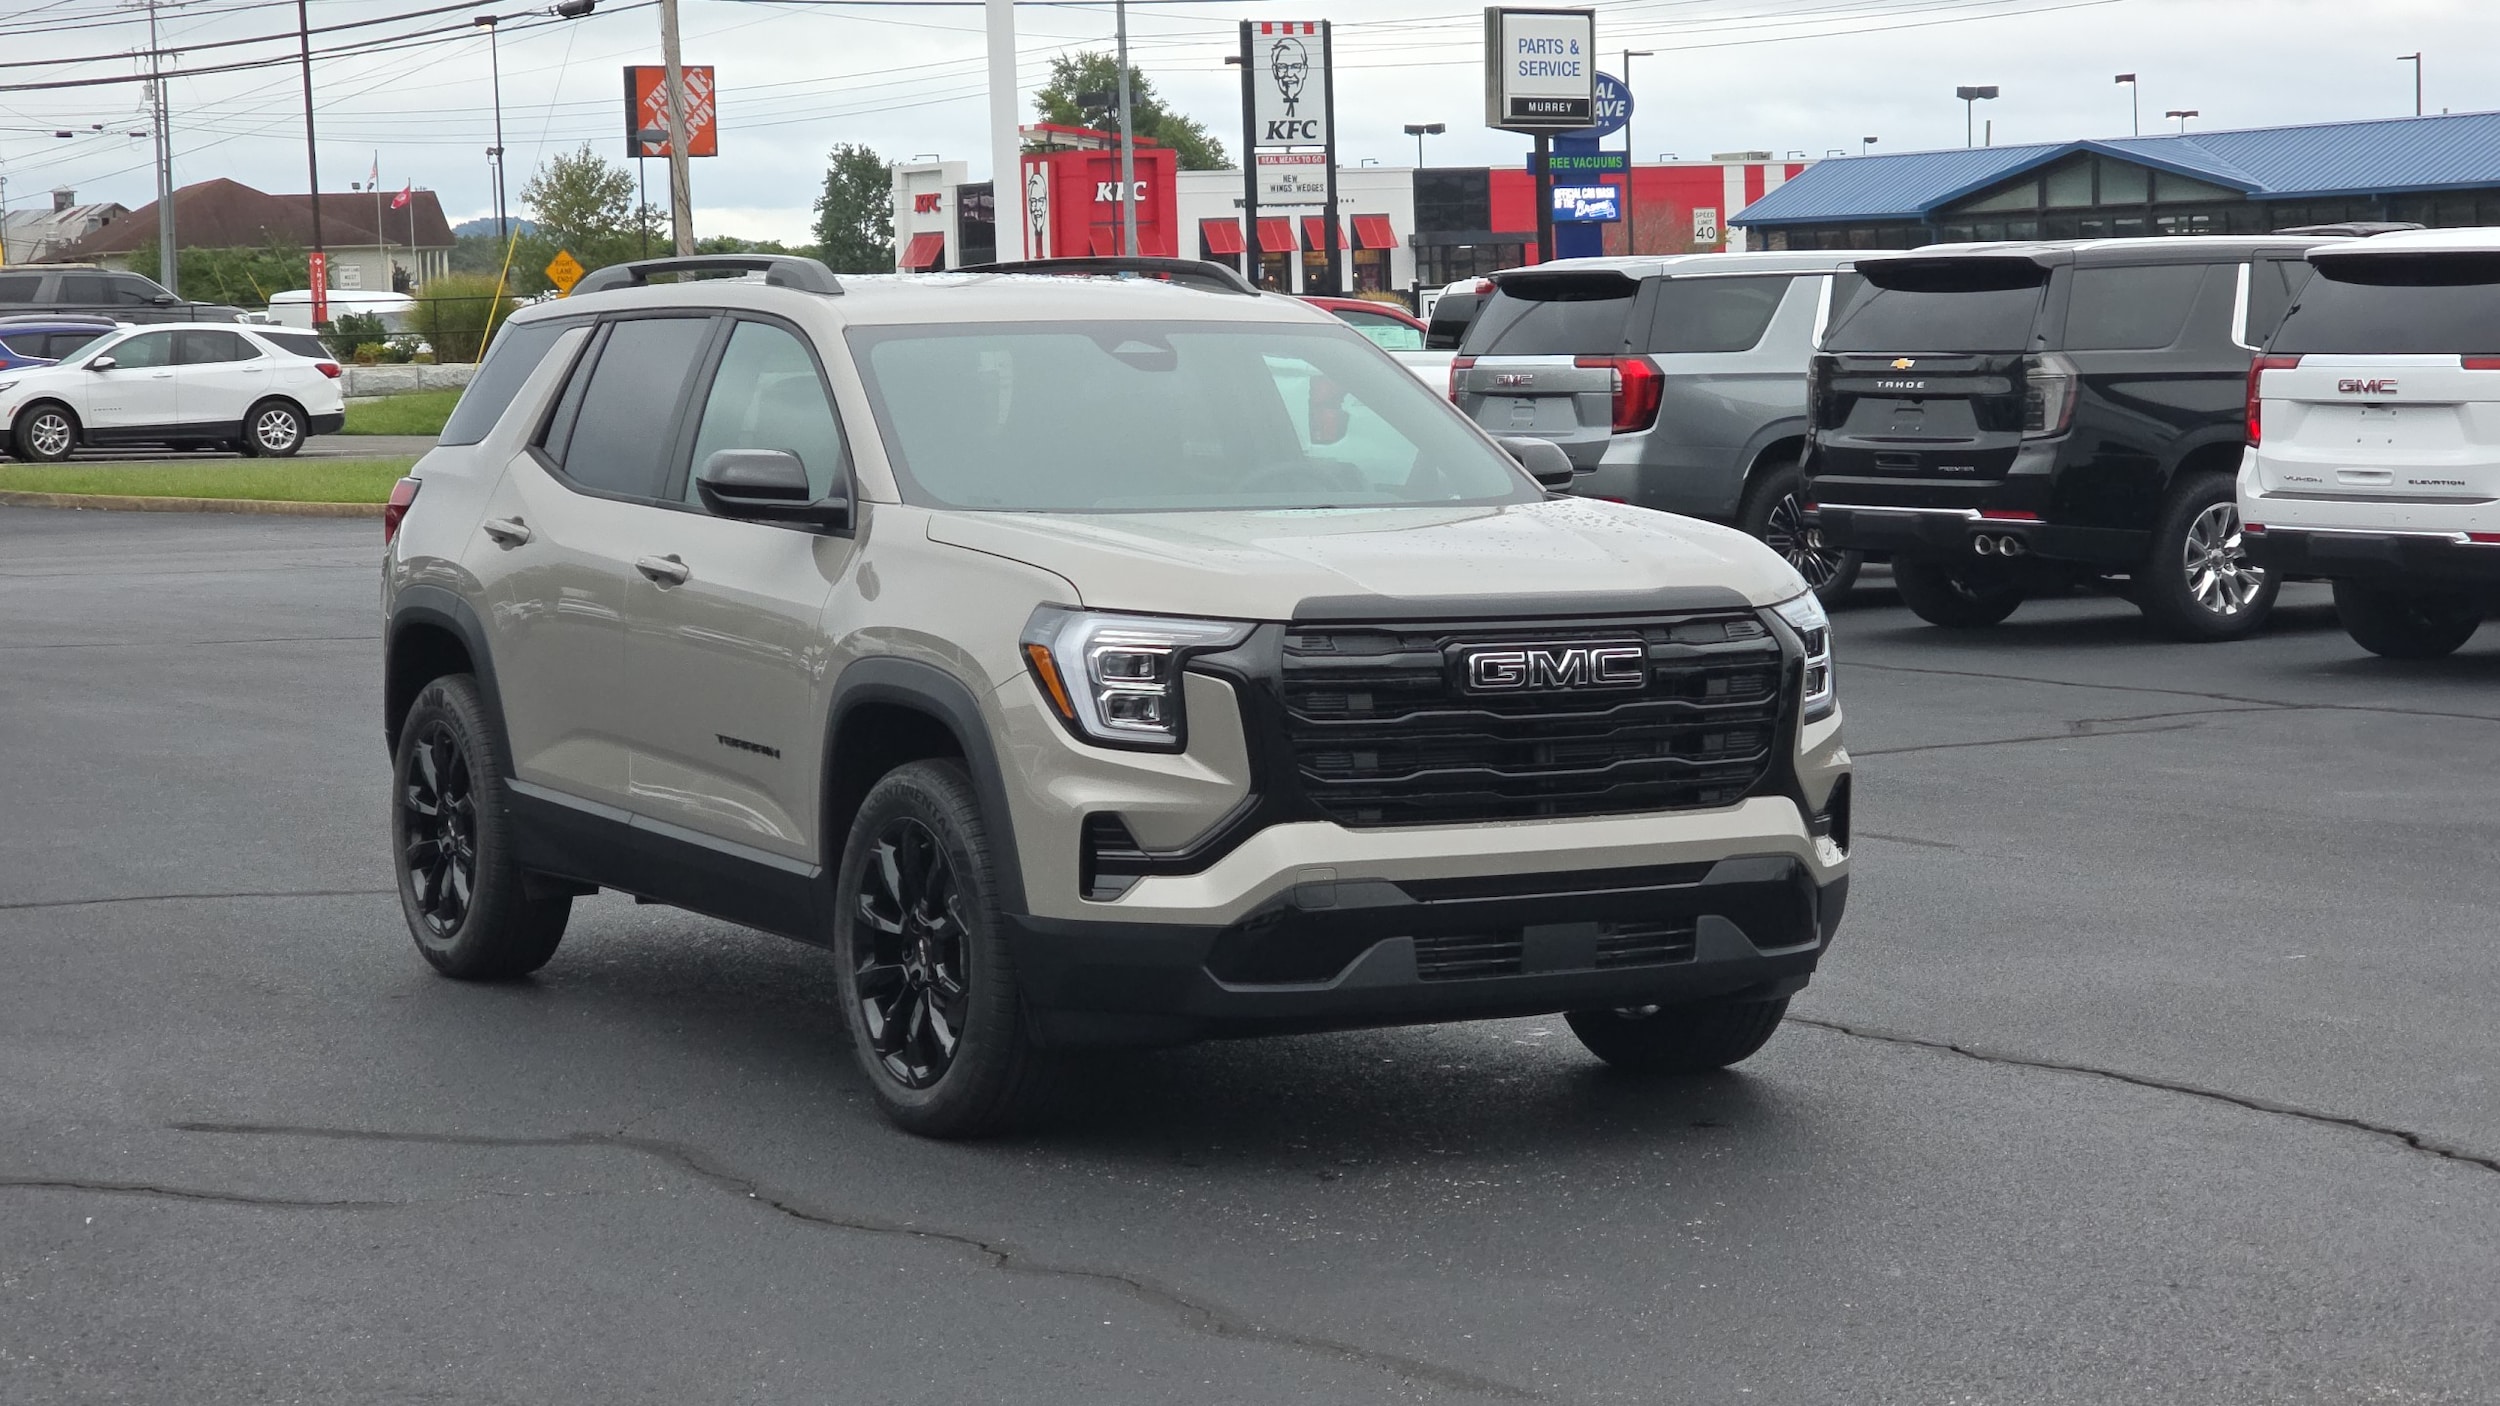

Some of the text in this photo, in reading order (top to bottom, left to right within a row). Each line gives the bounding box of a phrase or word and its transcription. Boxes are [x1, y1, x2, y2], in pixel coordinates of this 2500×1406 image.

[1518, 38, 1580, 54] PARTS &
[1518, 60, 1581, 76] SERVICE
[1595, 82, 1616, 99] AL
[1528, 102, 1572, 112] MURREY
[1595, 100, 1626, 117] AVE
[1265, 120, 1318, 140] KFC
[1549, 156, 1623, 168] REE VACUUMS
[1283, 175, 1298, 183] NEW
[1270, 184, 1324, 192] WINGS WEDGES
[913, 193, 941, 213] KFC
[1696, 226, 1716, 239] 40
[1496, 374, 1533, 386] GMC
[1876, 381, 1925, 389] TAHOE
[2338, 379, 2398, 395] GMC
[2284, 475, 2323, 484] YUKON
[1468, 647, 1643, 689] GMC
